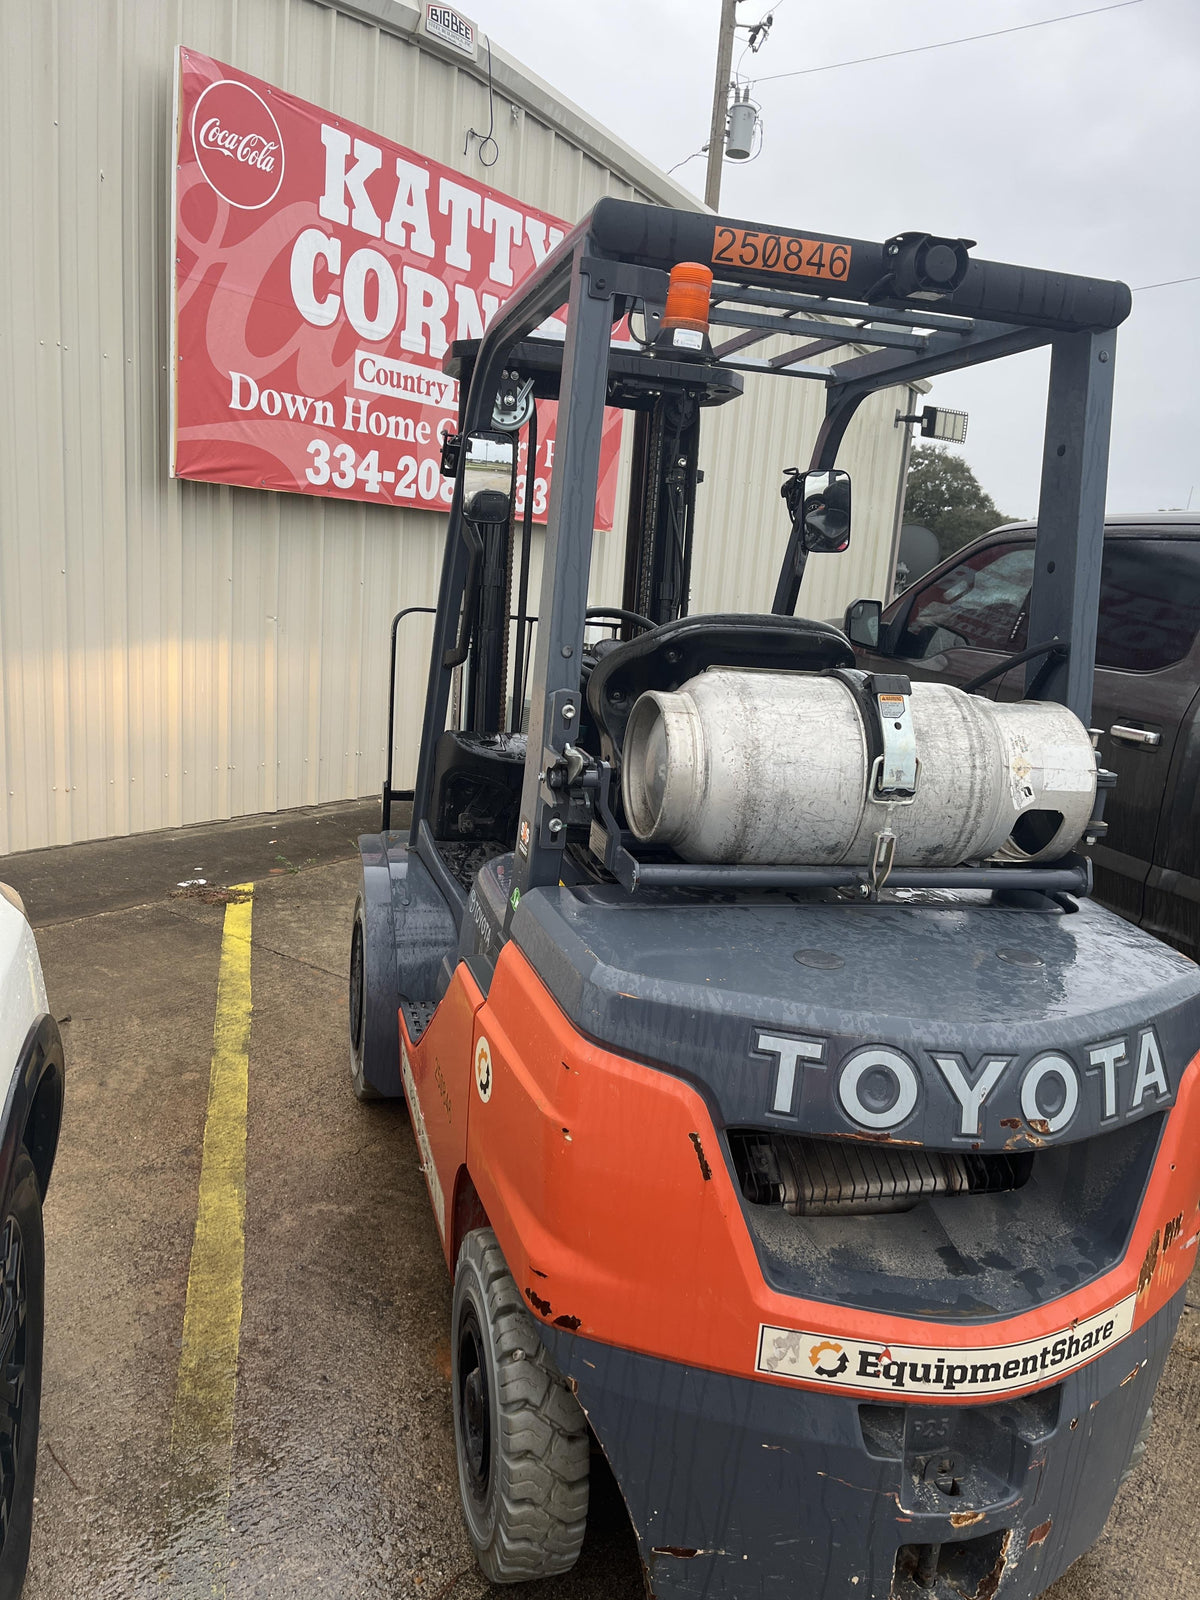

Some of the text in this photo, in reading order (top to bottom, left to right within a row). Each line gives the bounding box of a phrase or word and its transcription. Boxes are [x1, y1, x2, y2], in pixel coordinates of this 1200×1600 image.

[430, 8, 471, 40] BIGBEE
[200, 117, 279, 173] Coca-Cola
[714, 228, 848, 278] 250846
[228, 370, 335, 428] Down
[342, 395, 431, 444] Home
[358, 357, 448, 404] Country
[757, 1031, 1170, 1135] TOYOTA
[855, 1319, 1116, 1390] EquipmentShare
